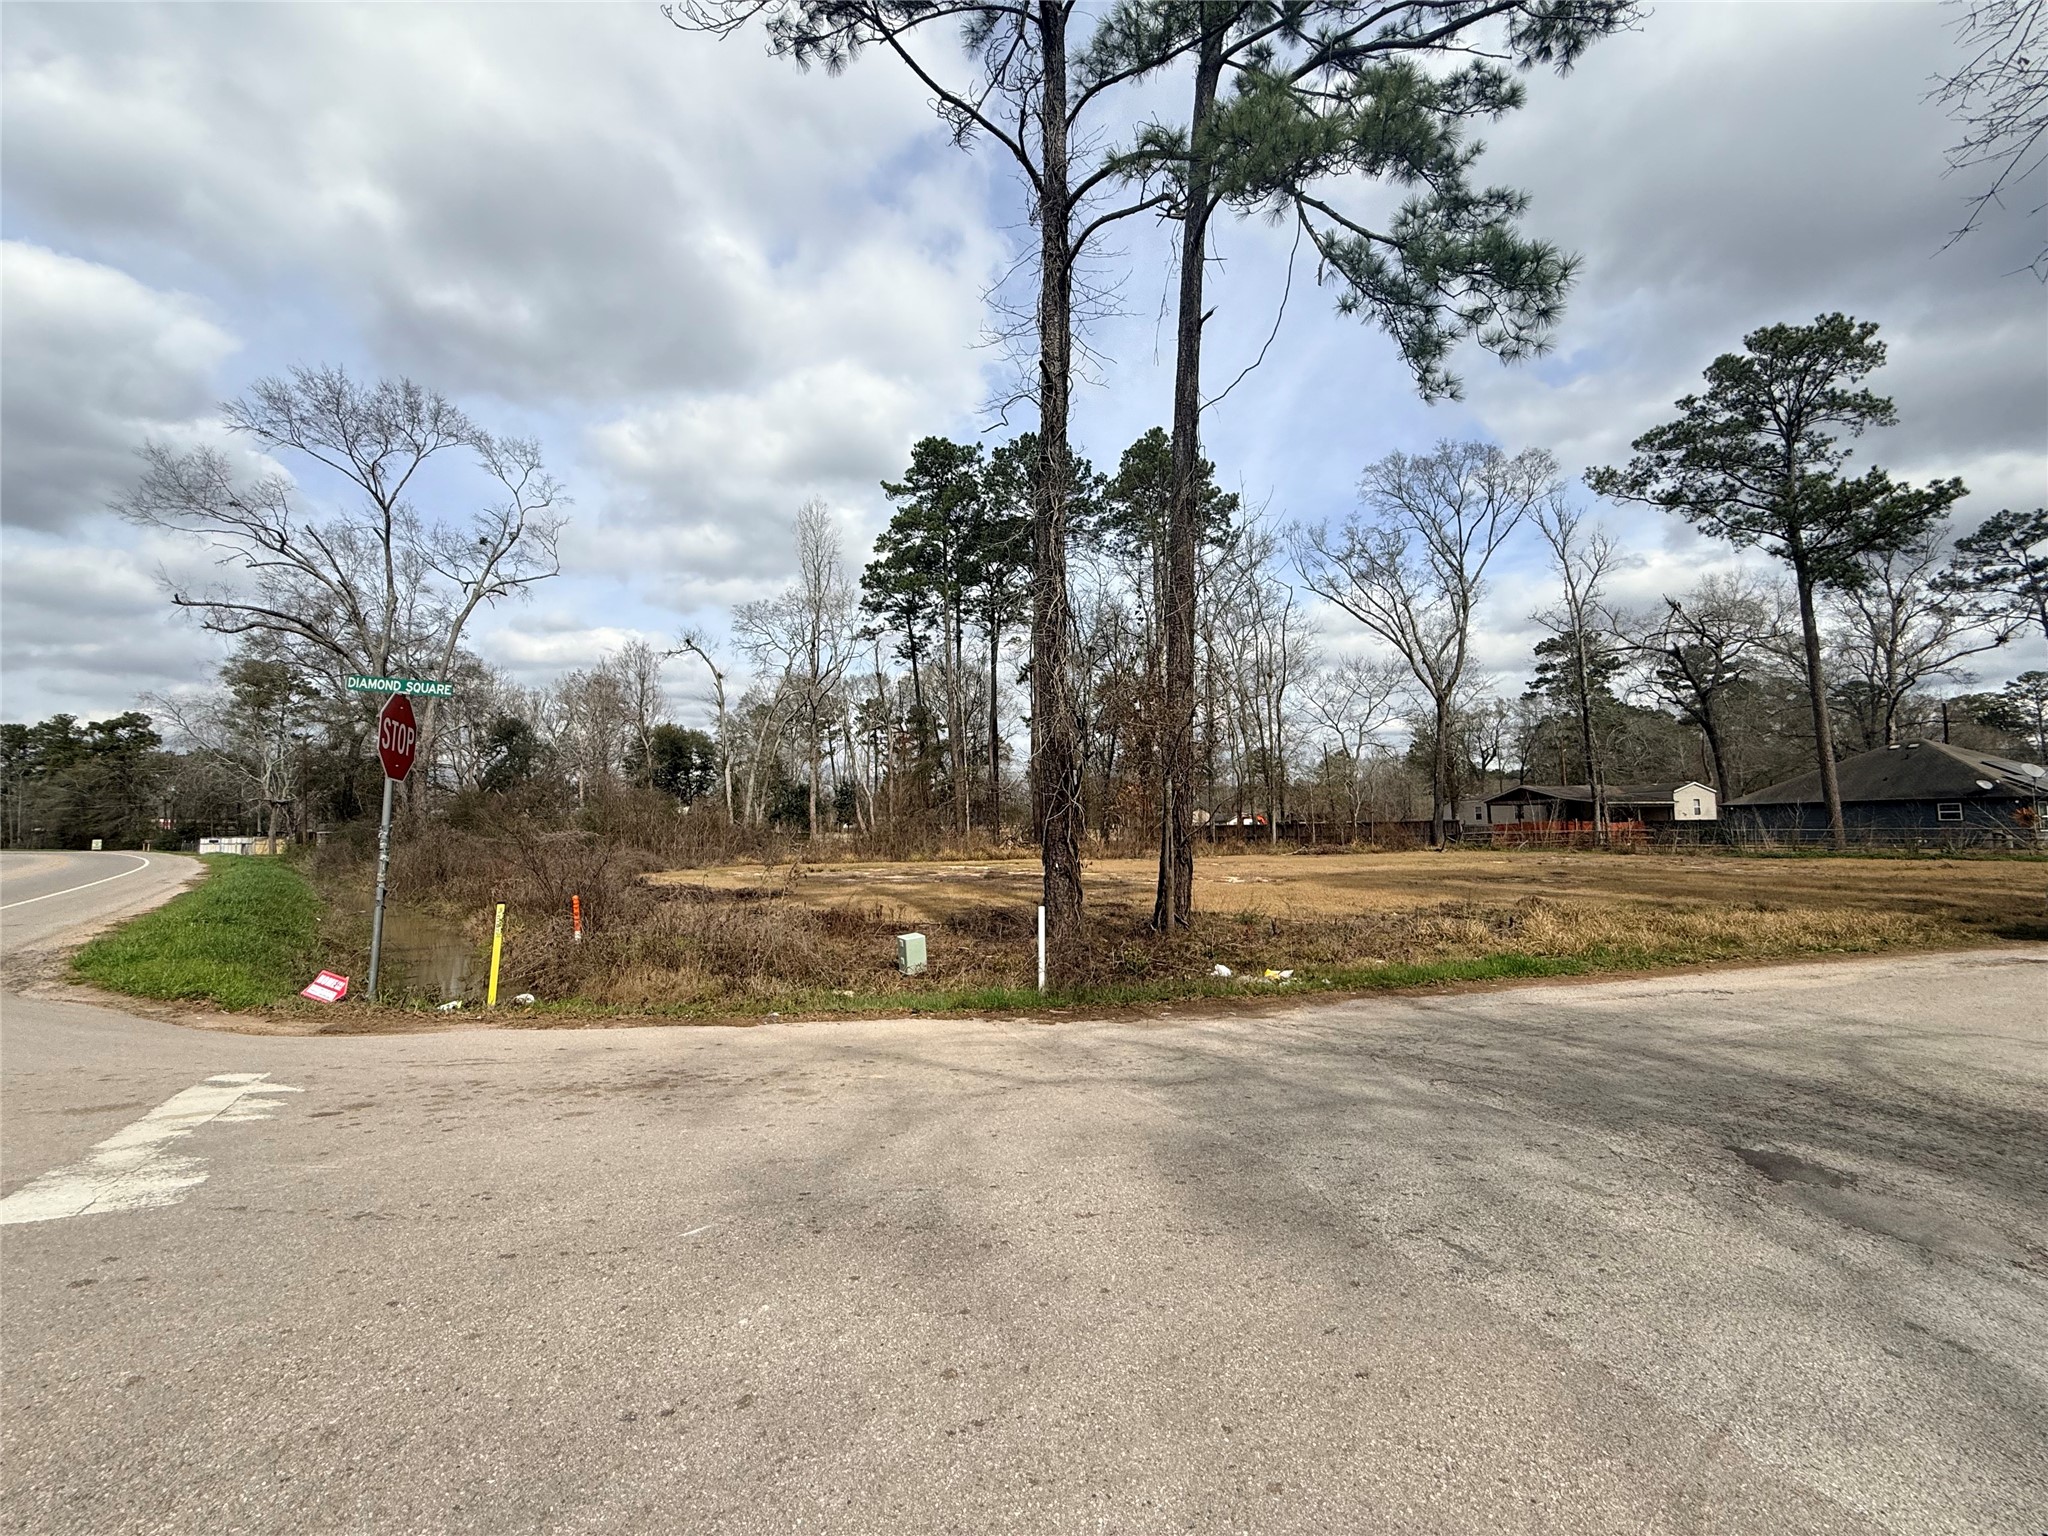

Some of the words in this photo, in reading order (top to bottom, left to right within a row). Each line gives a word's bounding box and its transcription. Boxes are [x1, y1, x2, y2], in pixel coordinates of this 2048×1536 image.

[348, 677, 401, 691] DIAMOND
[405, 681, 452, 695] SQUARE
[381, 717, 415, 756] STOP
